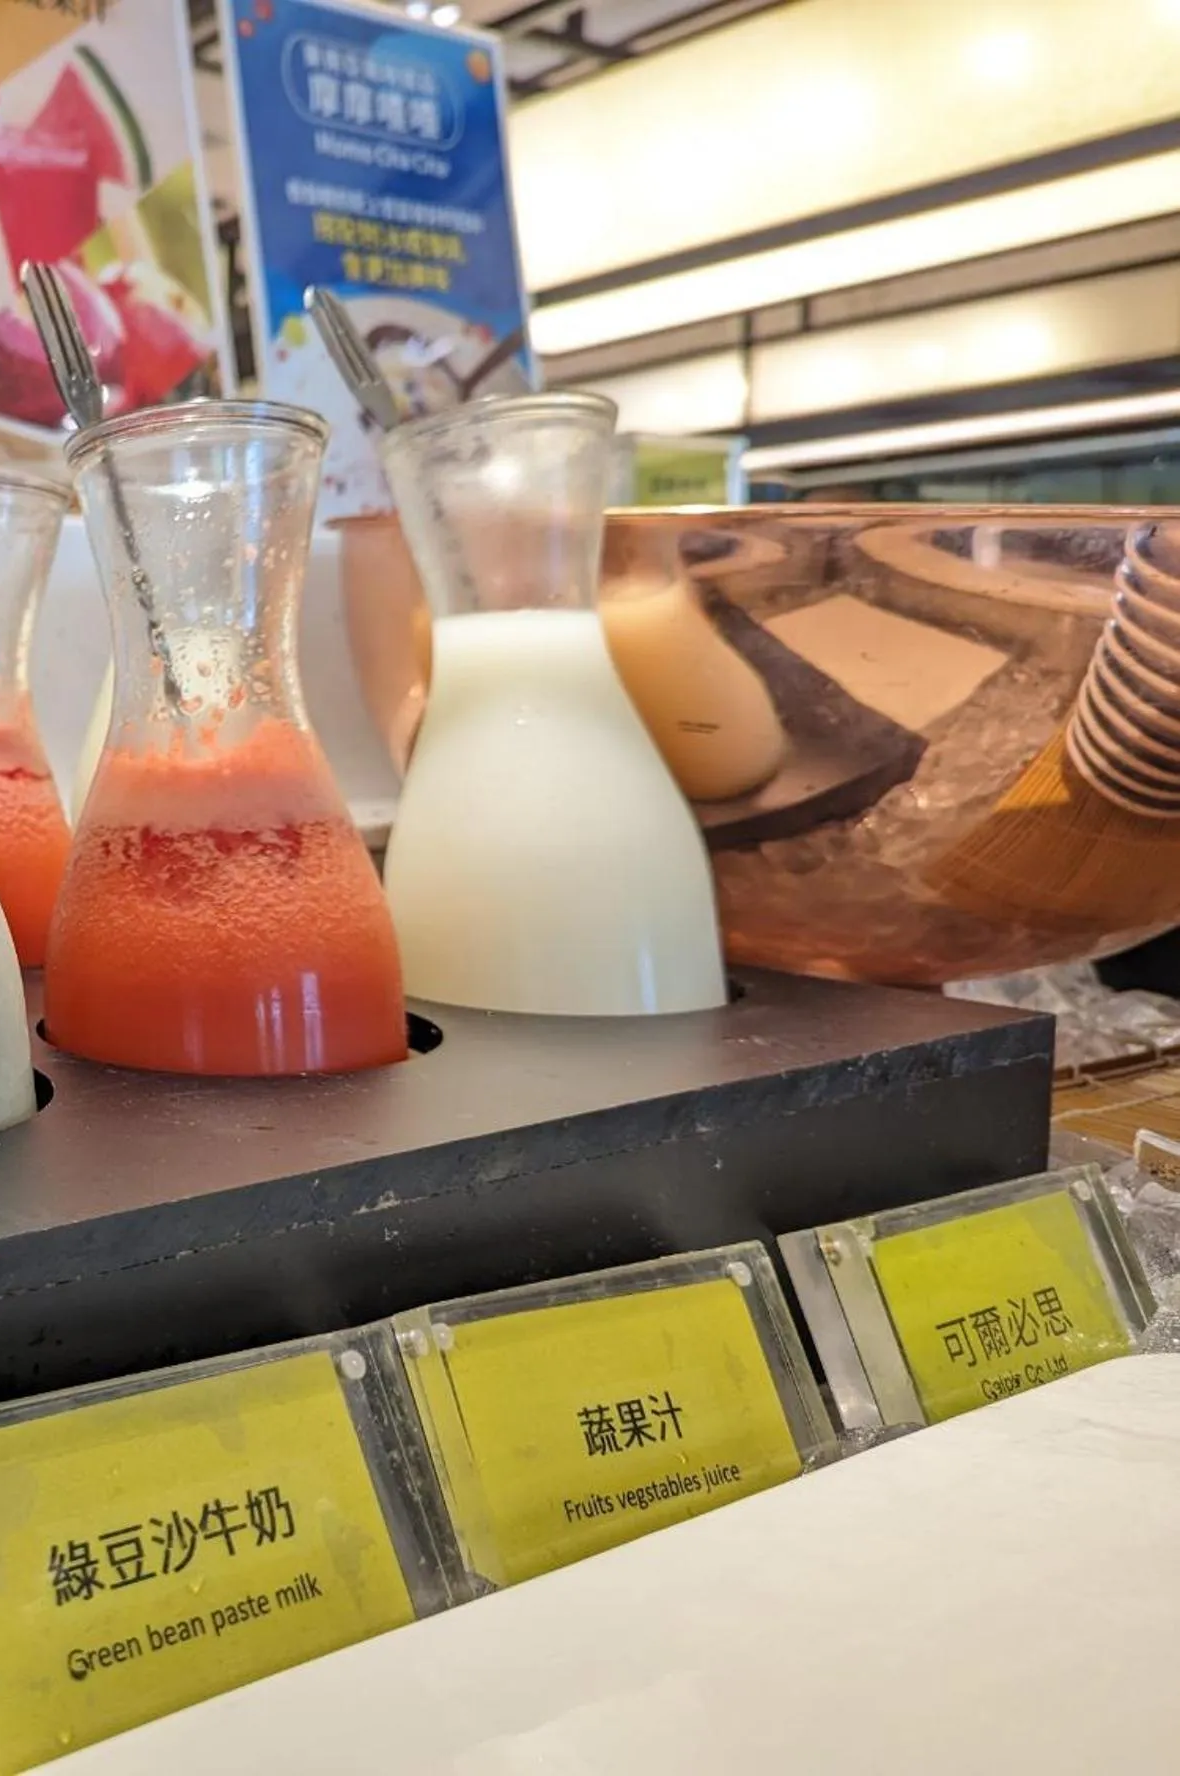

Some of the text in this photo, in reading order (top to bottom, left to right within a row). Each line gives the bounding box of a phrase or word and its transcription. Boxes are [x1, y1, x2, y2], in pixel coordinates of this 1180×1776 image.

[935, 1286, 1074, 1367] 可爾必思
[577, 1391, 684, 1456] 蔬果汁
[564, 1463, 741, 1523] Fruits vegstables juice
[48, 1486, 297, 1606] 綠豆沙牛奶
[67, 1572, 324, 1681] Green bean paste milk
